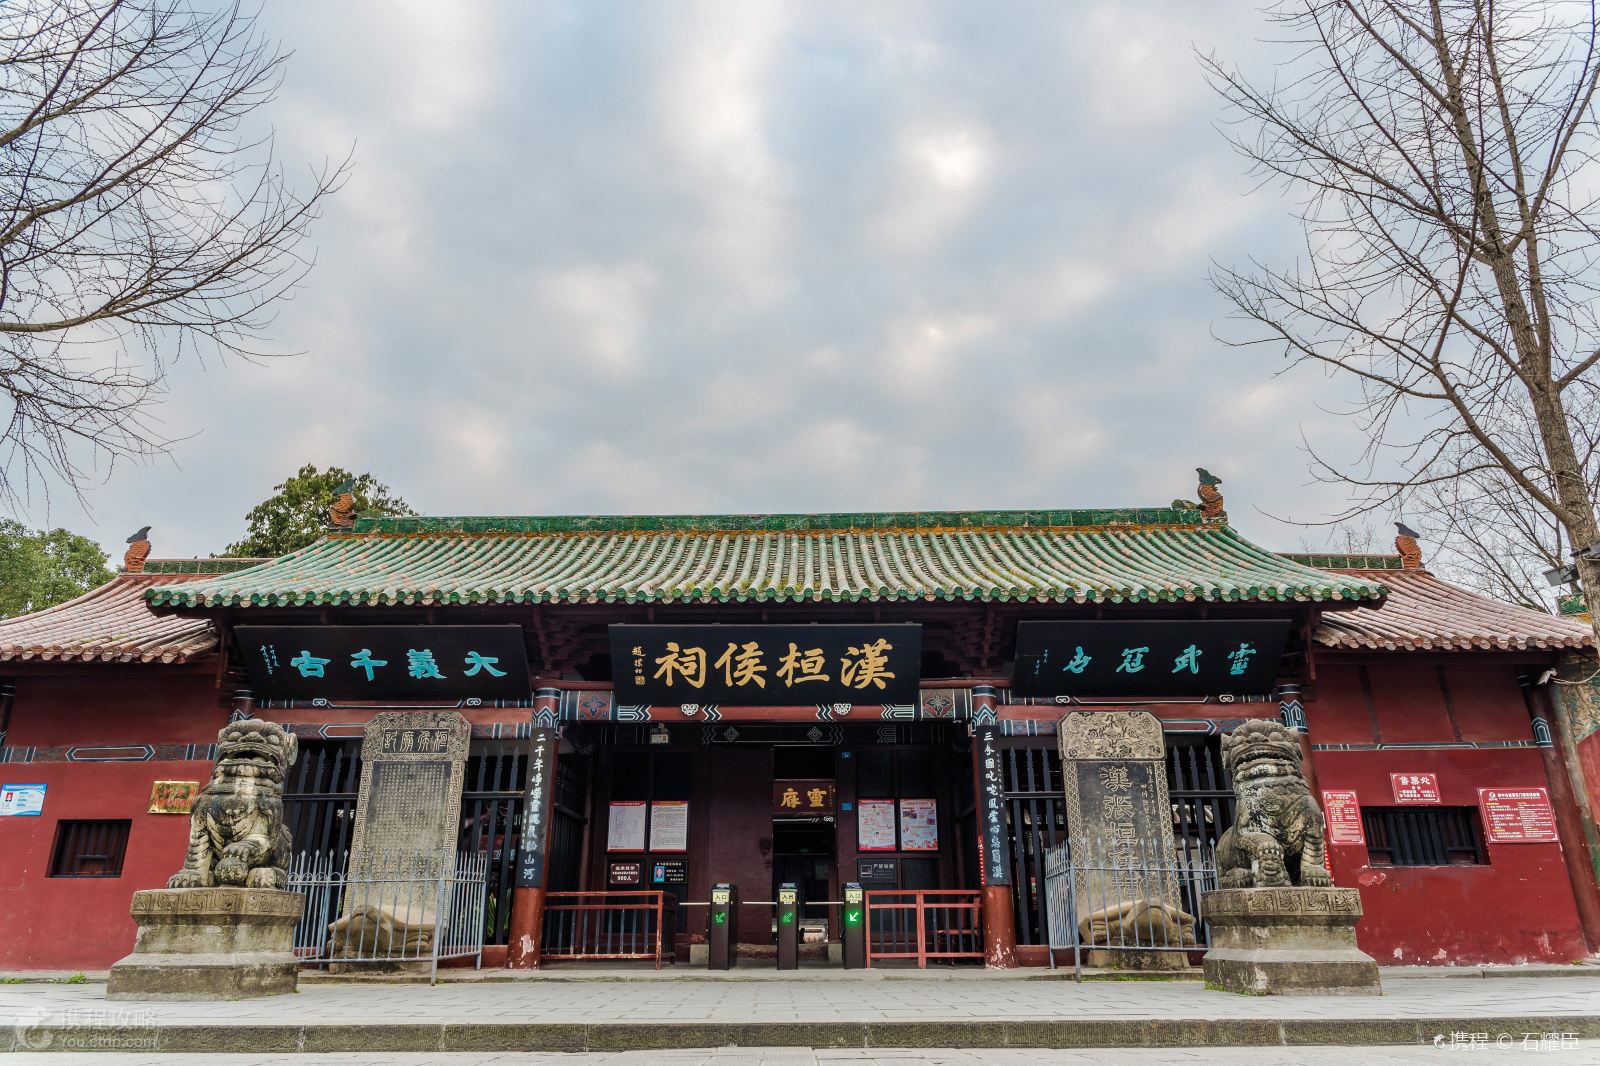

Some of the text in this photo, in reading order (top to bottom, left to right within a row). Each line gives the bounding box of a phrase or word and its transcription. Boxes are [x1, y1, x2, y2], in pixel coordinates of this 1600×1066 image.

[290, 649, 508, 682] 大義千古
[653, 638, 896, 690] 漢桓侯祠
